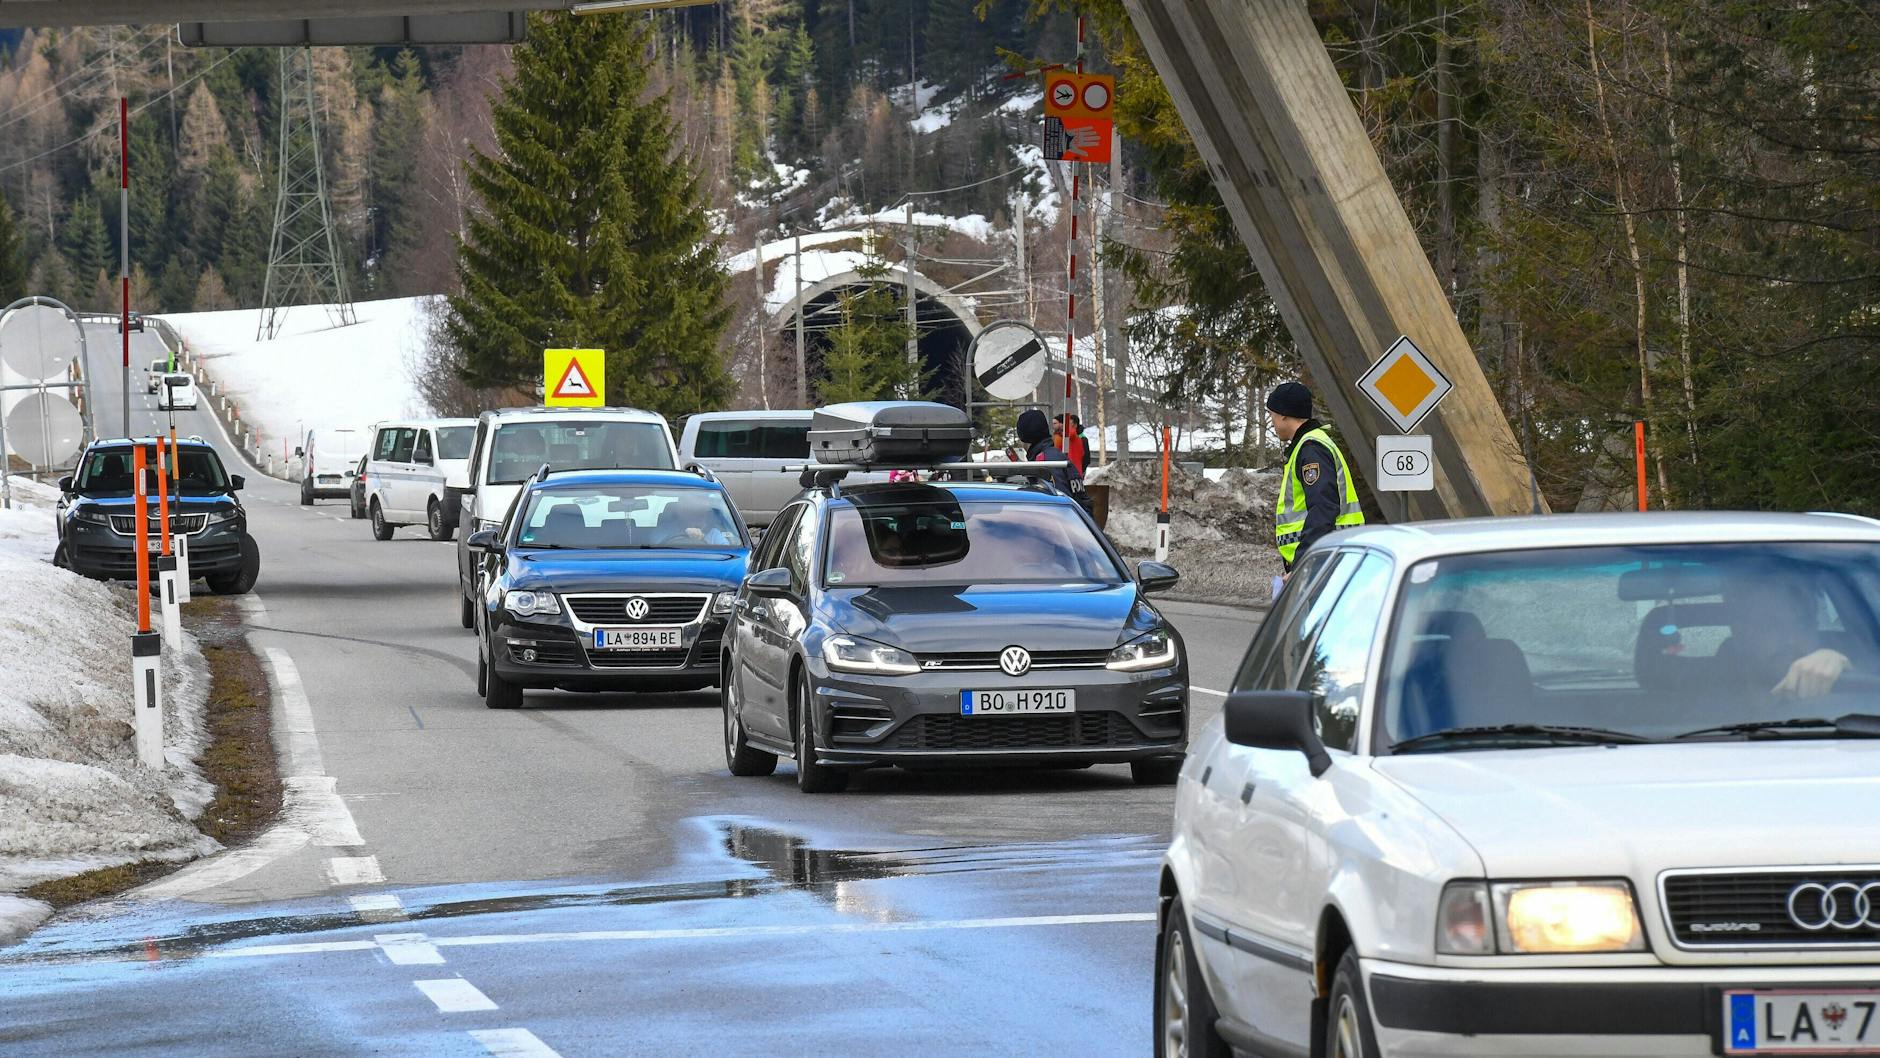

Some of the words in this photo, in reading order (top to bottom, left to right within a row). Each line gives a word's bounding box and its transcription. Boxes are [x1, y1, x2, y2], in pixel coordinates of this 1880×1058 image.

[1396, 455, 1414, 471] 68
[607, 632, 622, 645] LA
[632, 632, 657, 645] 894
[660, 632, 676, 645] BE
[980, 693, 1004, 711] BO
[1017, 693, 1028, 710] H
[1033, 692, 1066, 710] 910
[1737, 1028, 1750, 1042] A
[1765, 1001, 1818, 1042] LA
[1853, 1001, 1877, 1042] 7
